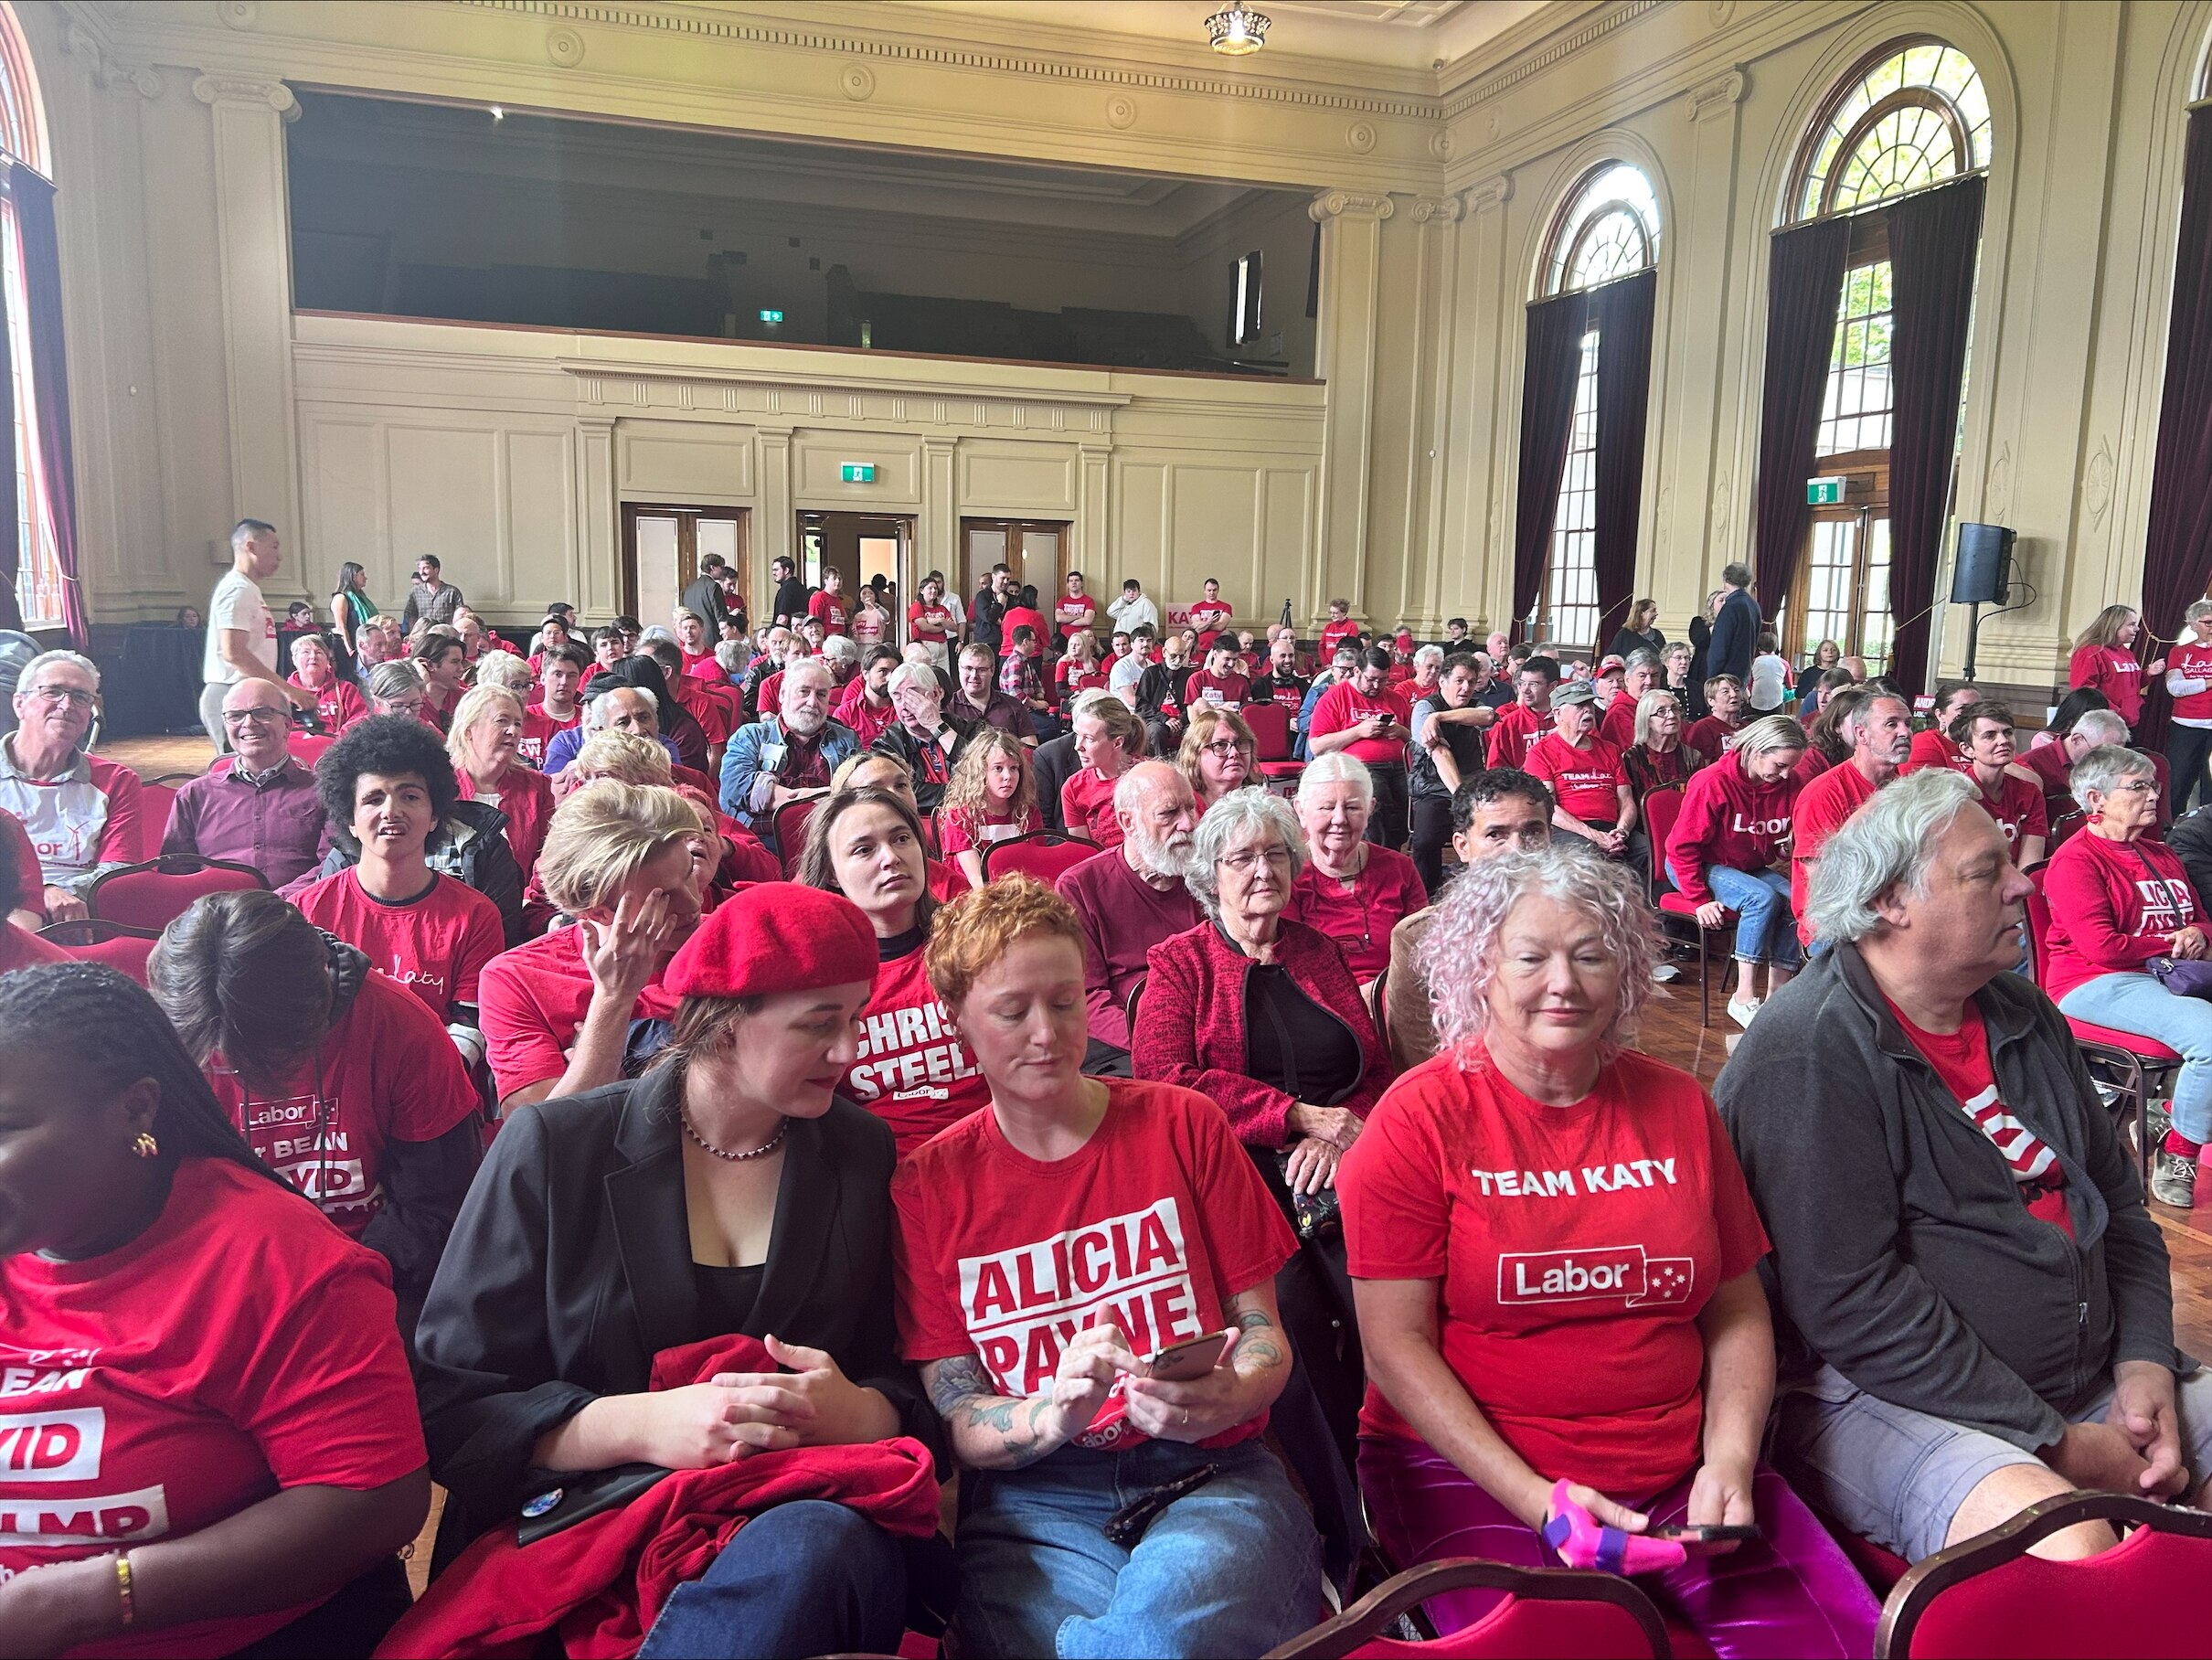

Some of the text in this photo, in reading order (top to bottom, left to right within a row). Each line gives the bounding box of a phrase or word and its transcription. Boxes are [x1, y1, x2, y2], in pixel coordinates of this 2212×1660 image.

[1168, 612, 1192, 623] KA
[849, 1042, 984, 1101] STEEL
[273, 1131, 348, 1159] BEAN
[1471, 1157, 1677, 1197] TEAM KATY
[972, 1209, 1180, 1322] ALICIA
[1515, 1259, 1630, 1296] Labor
[1081, 1419, 1124, 1448] abor
